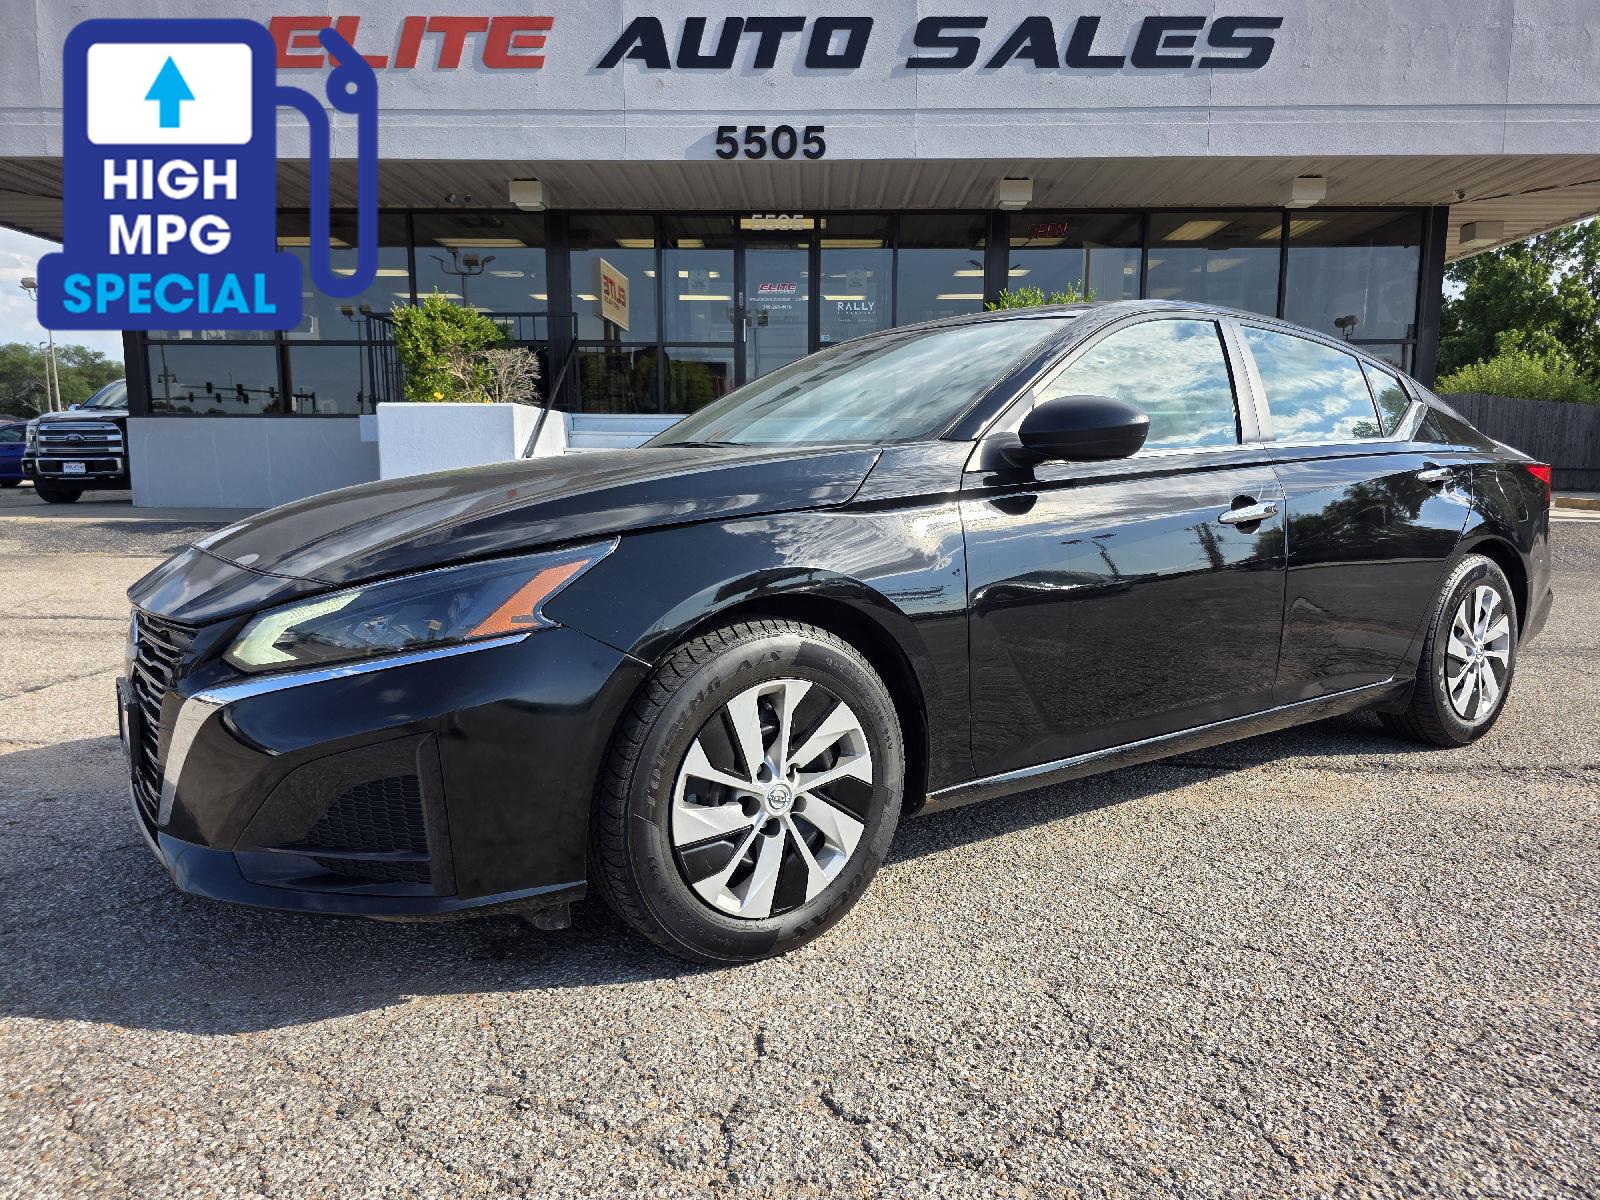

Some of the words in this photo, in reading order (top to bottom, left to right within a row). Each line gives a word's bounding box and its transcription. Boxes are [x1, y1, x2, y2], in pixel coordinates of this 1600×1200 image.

[597, 16, 874, 69] AUTO
[906, 16, 1283, 69] SALES
[715, 125, 826, 159] 5505
[751, 214, 804, 231] 5505
[1026, 222, 1069, 239] OPEN
[758, 282, 798, 291] ELITE
[837, 301, 875, 311] RALLY
